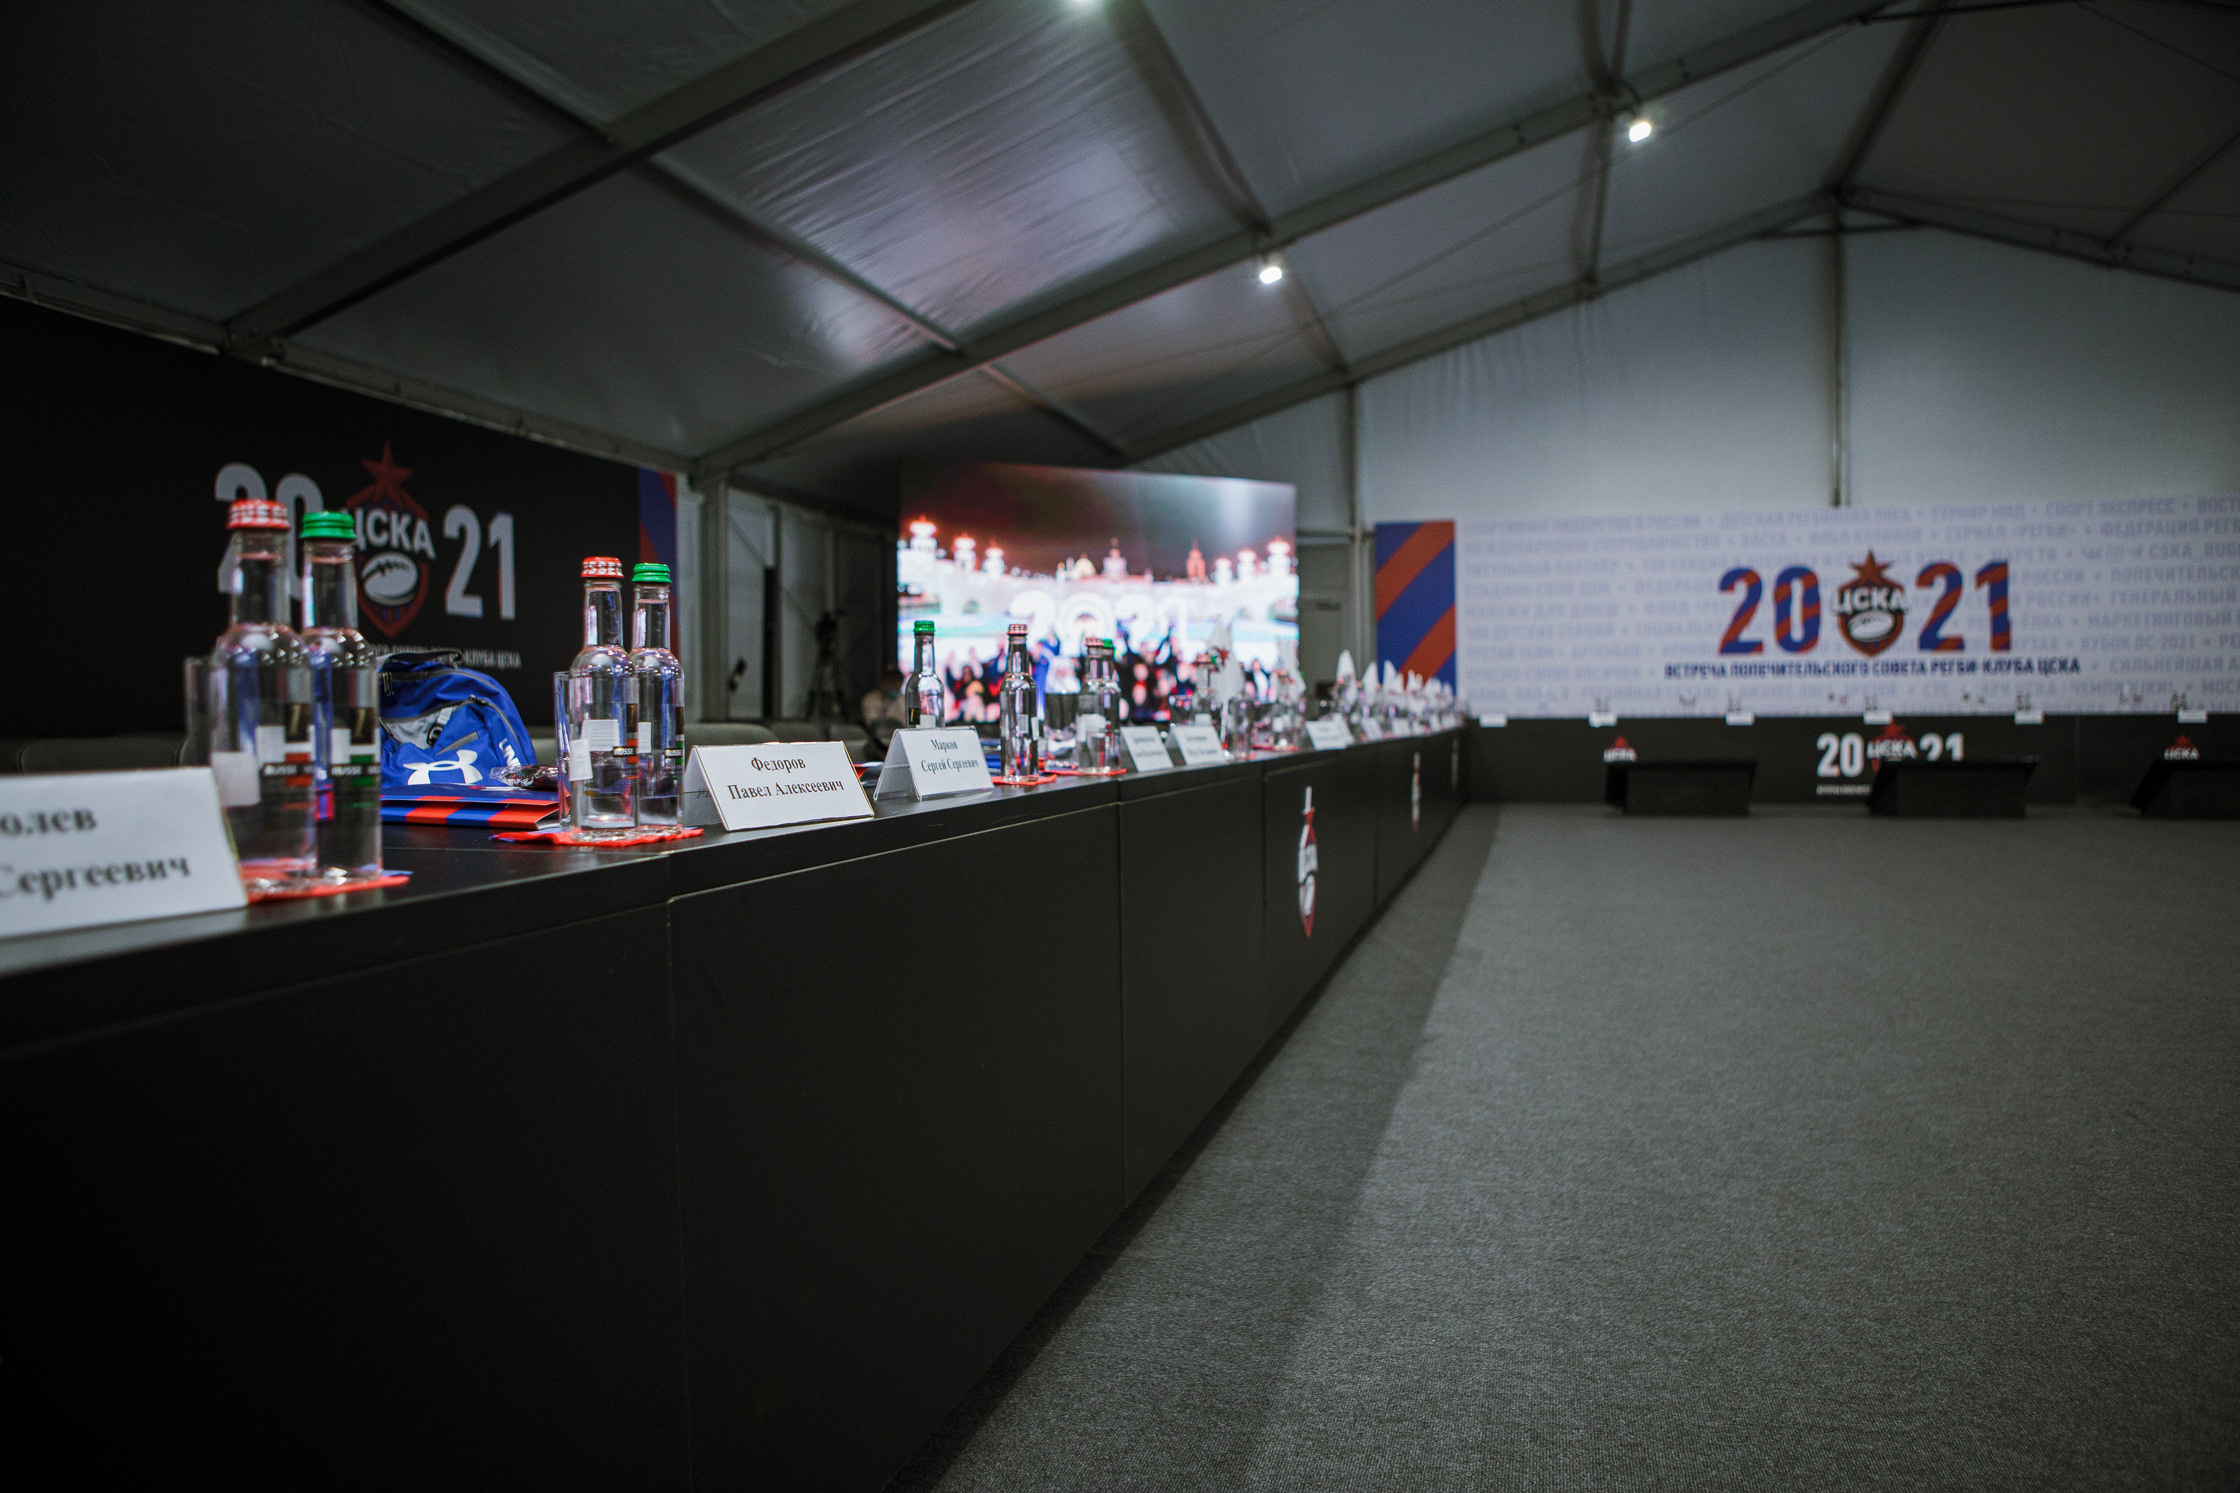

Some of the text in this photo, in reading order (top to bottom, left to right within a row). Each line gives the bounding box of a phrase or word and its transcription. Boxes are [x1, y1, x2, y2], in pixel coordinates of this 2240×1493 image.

[443, 503, 516, 620] 21
[1718, 560, 2011, 654] 20 ЦСКА 21
[1664, 661, 1727, 680] ВСТРЕЧА
[1873, 658, 1927, 677] СОВЕТА
[2037, 656, 2081, 677] ЦСКА
[930, 739, 958, 753] Марков
[1817, 732, 1864, 777] 20
[1919, 732, 1964, 761] 21
[751, 756, 806, 773] Федоров
[921, 757, 979, 774] Сергей Сергеевич
[727, 779, 845, 800] Павел Алексеевич
